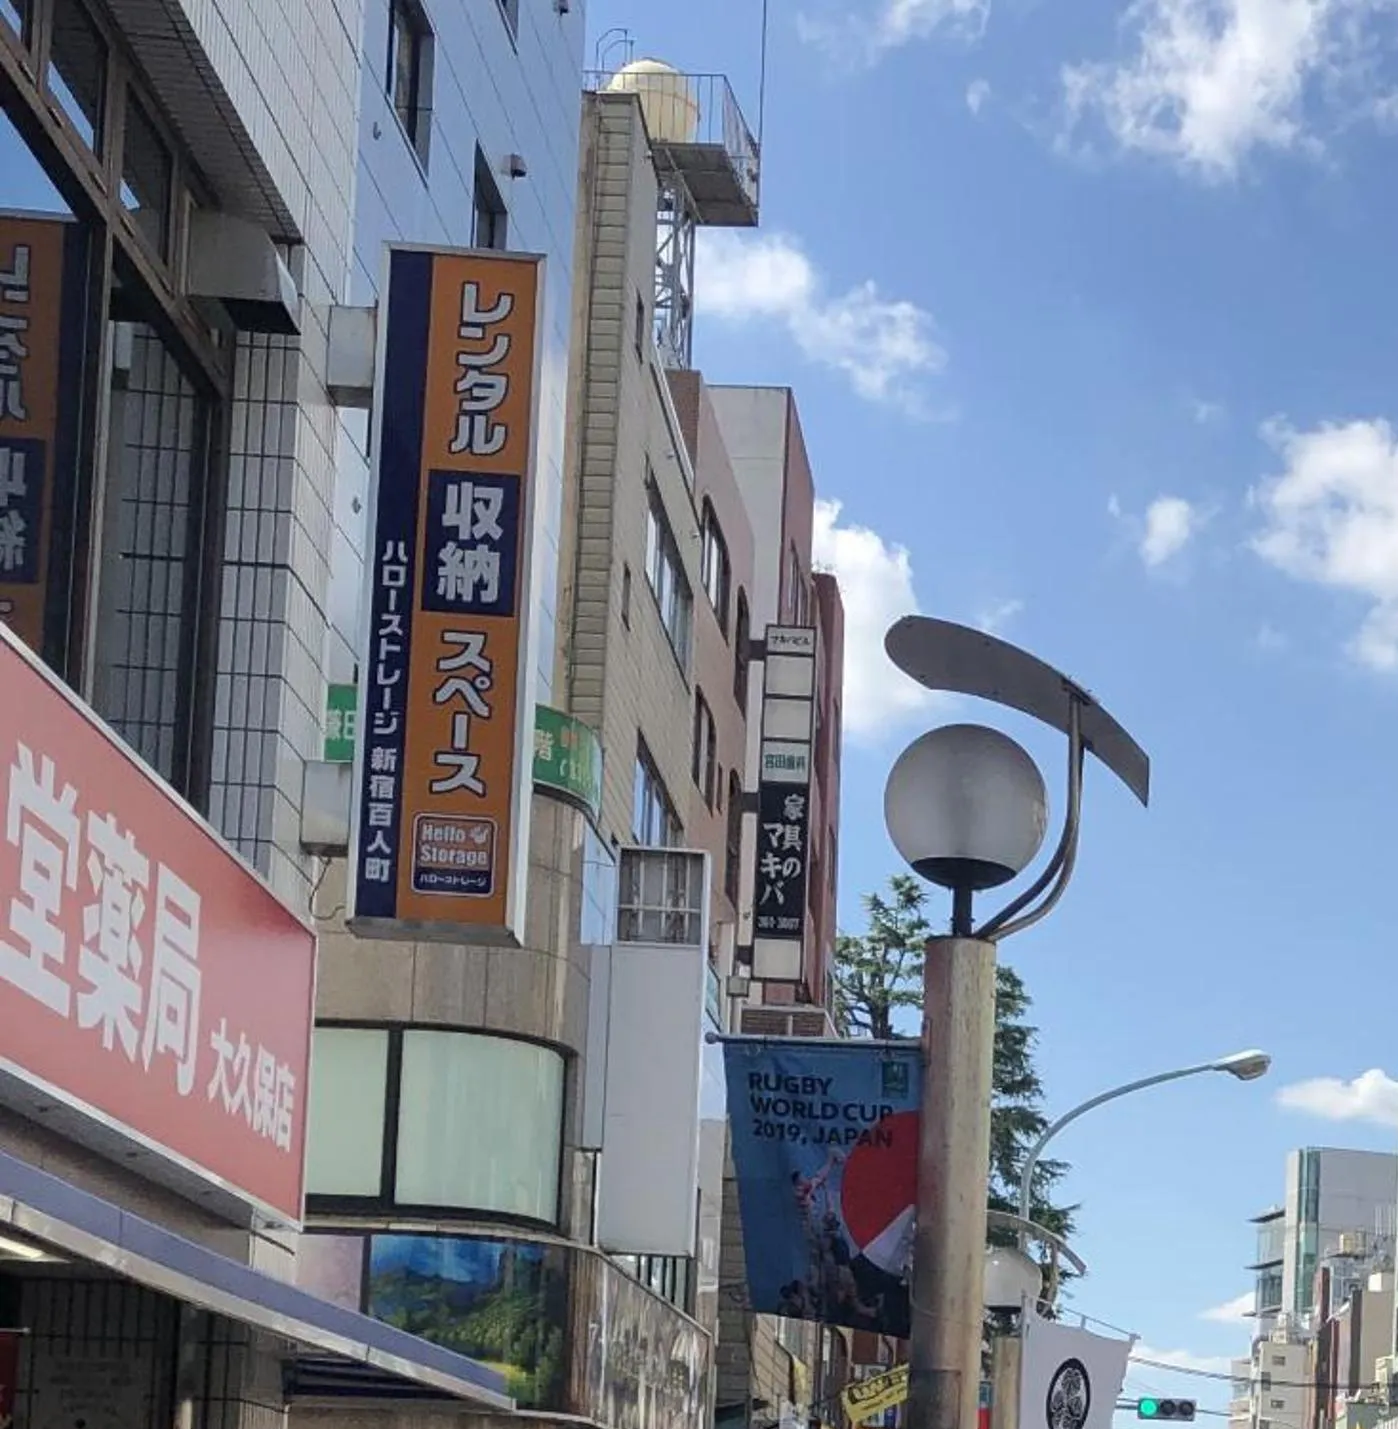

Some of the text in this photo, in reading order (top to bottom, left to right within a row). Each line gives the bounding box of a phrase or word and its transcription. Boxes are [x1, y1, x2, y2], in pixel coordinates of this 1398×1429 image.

[431, 281, 514, 797] レンタル 収納 スペース
[365, 540, 409, 883] ハローストレージ 新宿百人町
[421, 823, 466, 842] Hello
[420, 845, 488, 866] Storage
[759, 822, 785, 906] マキバ
[0, 740, 296, 1153] 堂薬局 大久保店
[748, 1072, 833, 1097] RUGBY
[750, 1096, 894, 1124] WORLD CUP
[752, 1118, 894, 1148] 2019, JAPAN
